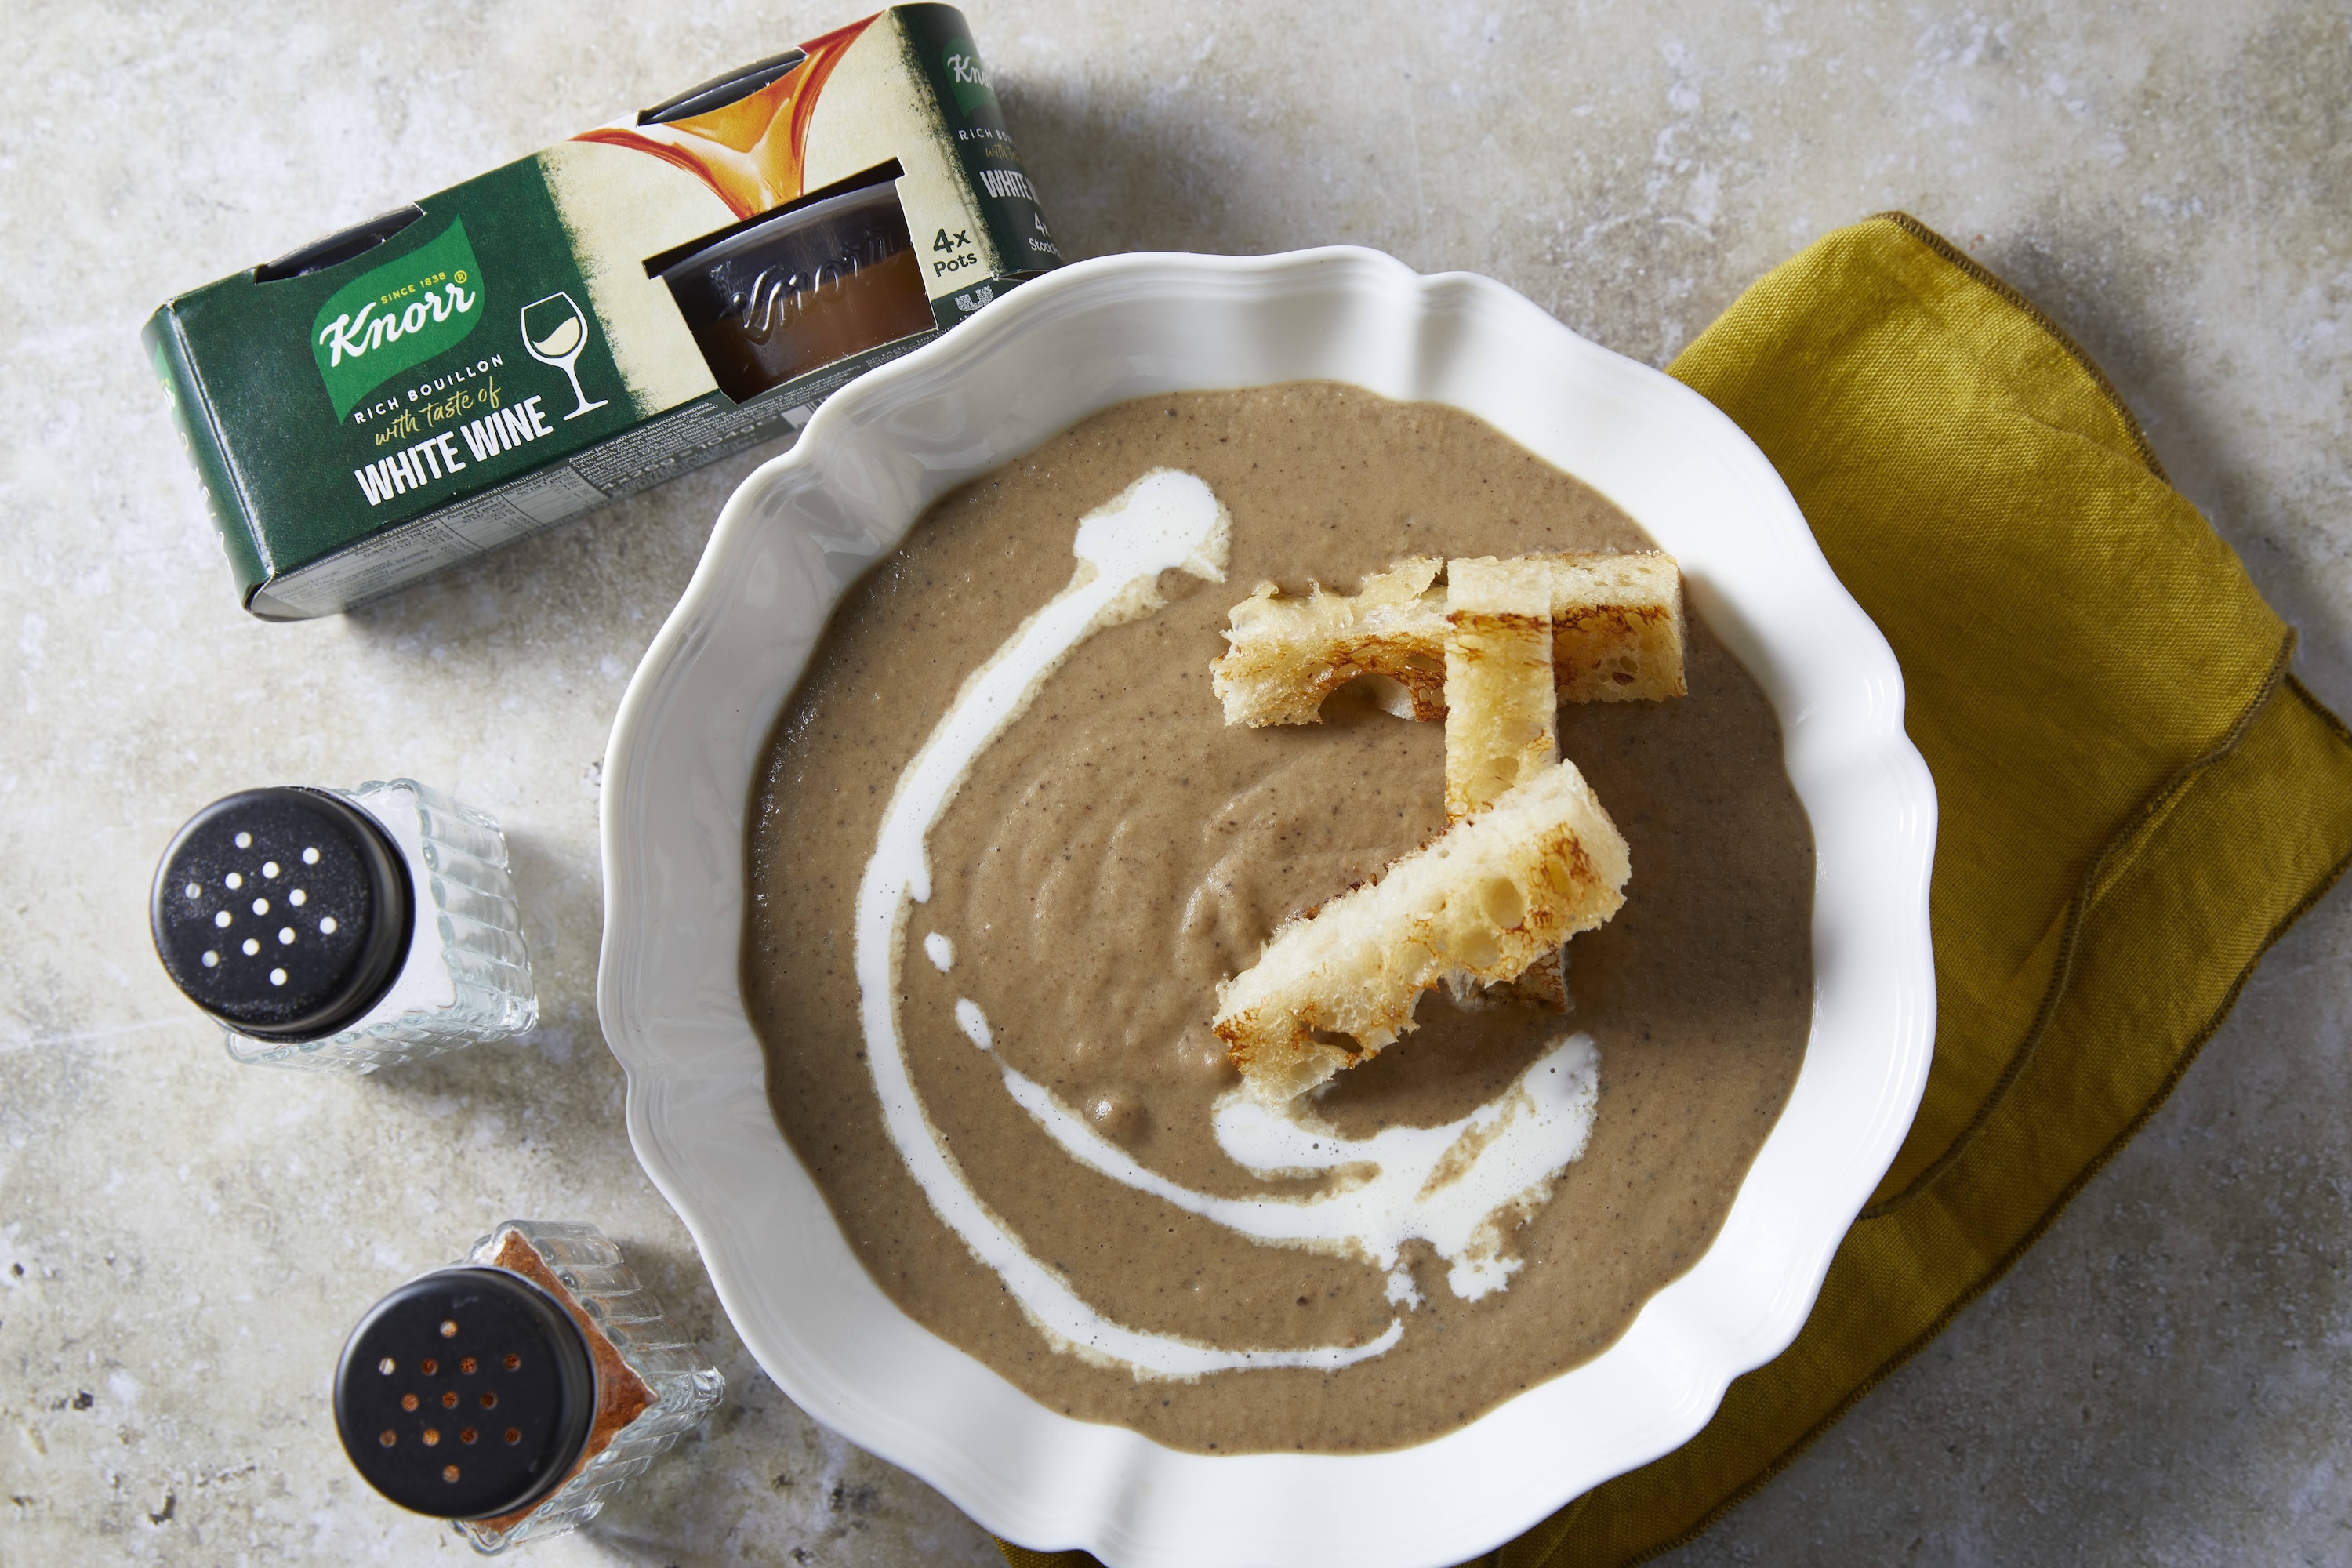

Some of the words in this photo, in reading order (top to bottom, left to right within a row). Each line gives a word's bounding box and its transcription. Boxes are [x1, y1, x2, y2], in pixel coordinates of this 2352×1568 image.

[958, 128, 993, 141] RICH
[985, 141, 1008, 160] with
[979, 170, 1033, 201] WHITE
[933, 228, 971, 254] 4x
[933, 252, 978, 278] Pots
[380, 284, 416, 304] SINCE
[420, 271, 447, 288] 1838
[319, 283, 475, 367] Knorr
[354, 397, 399, 424] RICH
[408, 354, 503, 401] BOUILLON
[376, 409, 421, 445] with
[419, 390, 474, 427] taste
[478, 376, 501, 408] of
[354, 431, 466, 506] WHITE
[459, 395, 554, 462] WINE
